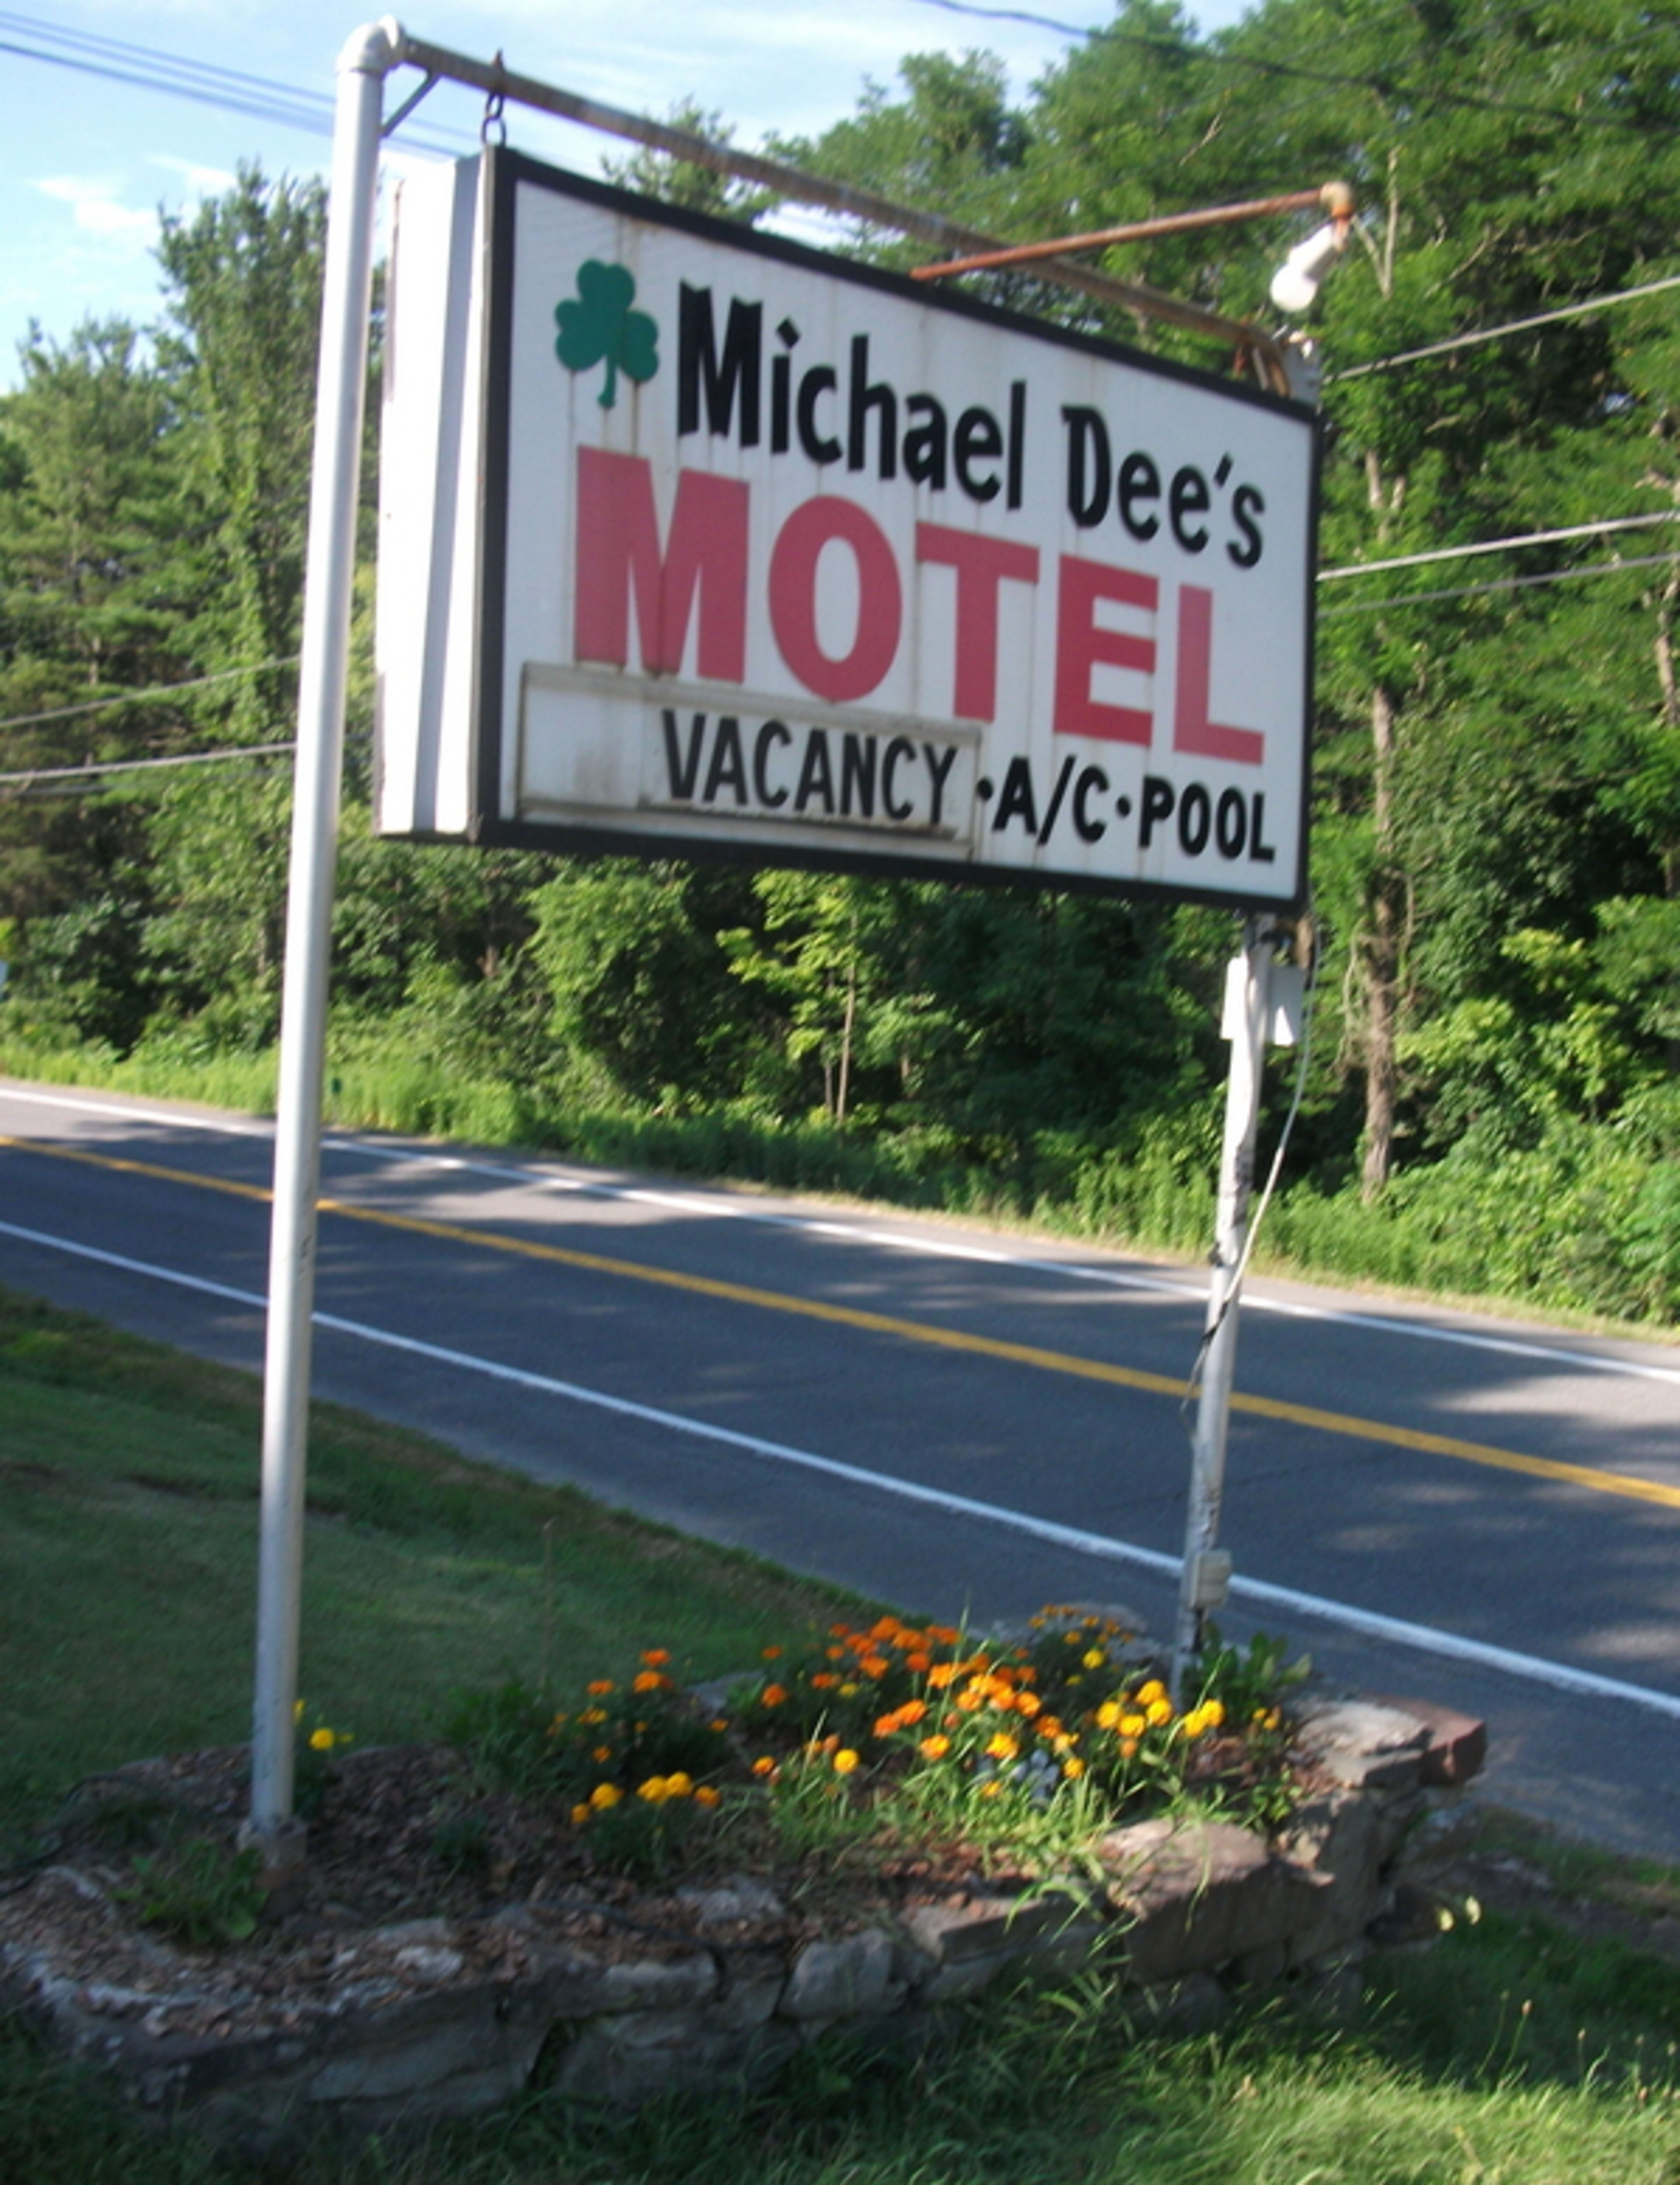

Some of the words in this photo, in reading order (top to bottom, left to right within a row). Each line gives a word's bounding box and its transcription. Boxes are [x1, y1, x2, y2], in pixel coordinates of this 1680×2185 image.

[678, 281, 1027, 511] Michael
[1061, 406, 1266, 568] Dee's
[575, 446, 1264, 766] MOTEL
[661, 709, 957, 826] VACANCY
